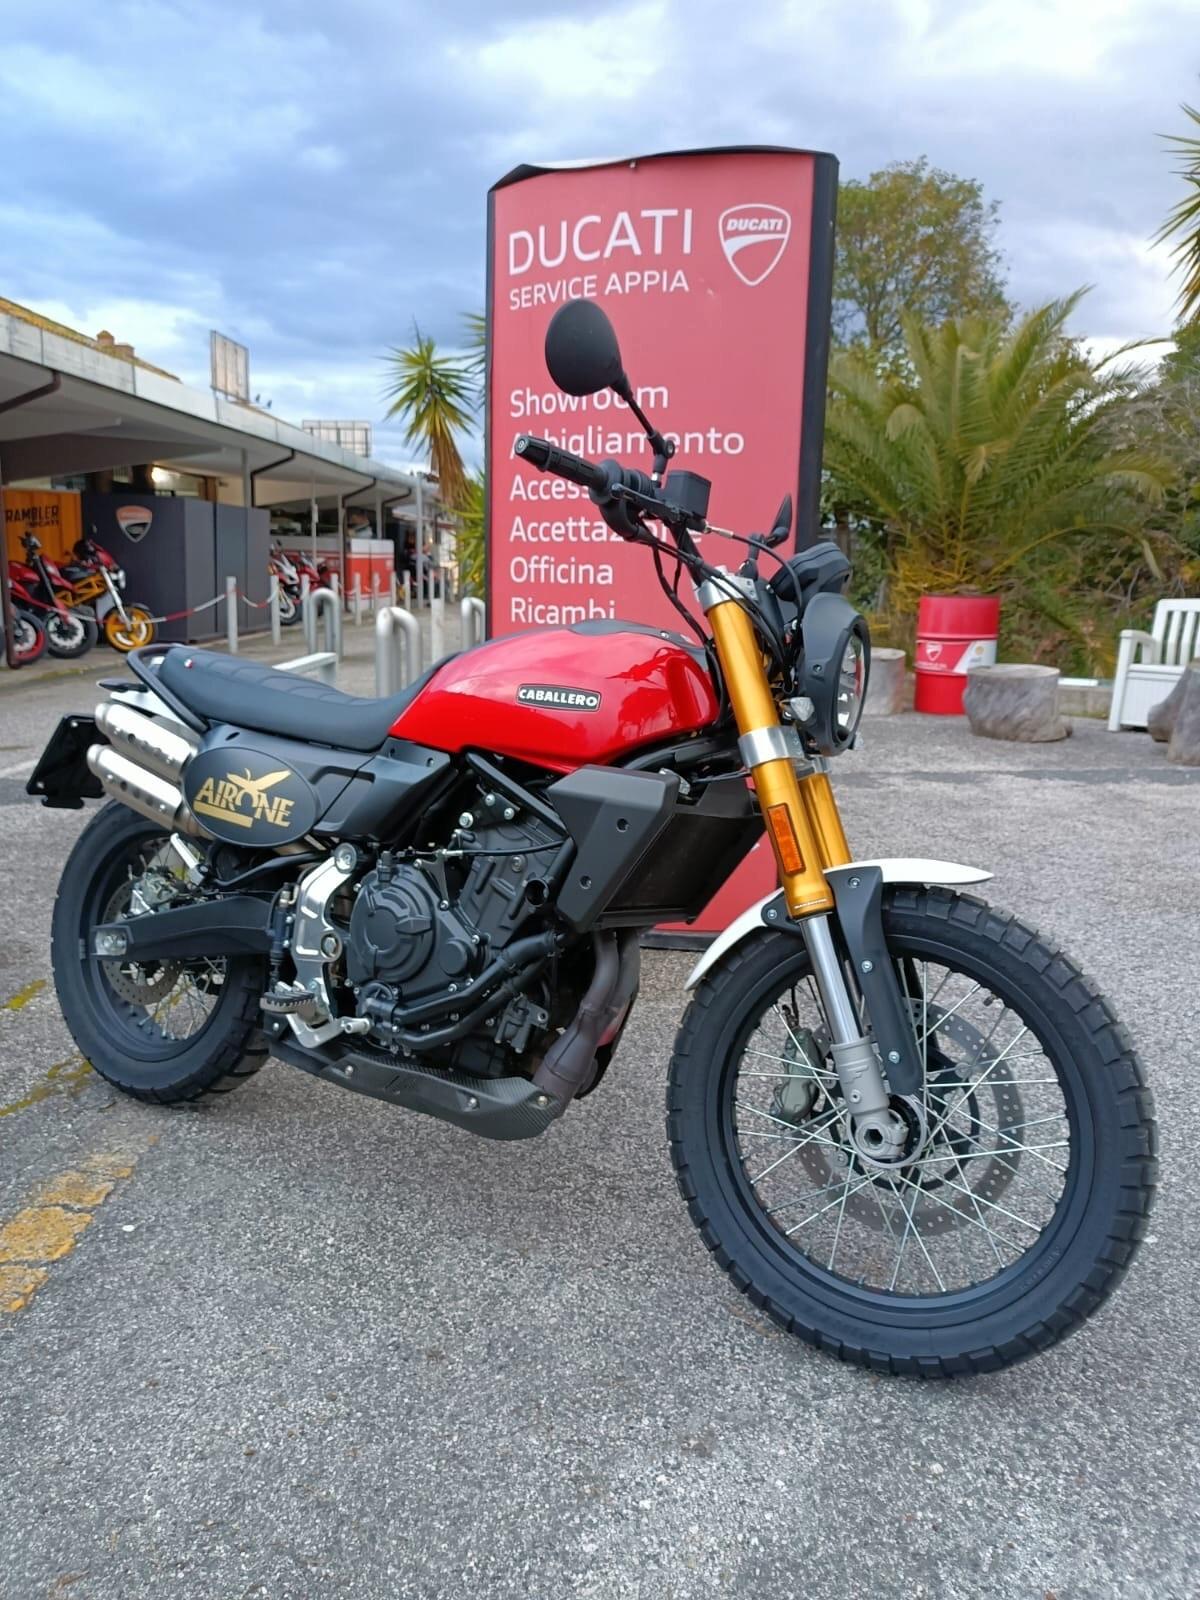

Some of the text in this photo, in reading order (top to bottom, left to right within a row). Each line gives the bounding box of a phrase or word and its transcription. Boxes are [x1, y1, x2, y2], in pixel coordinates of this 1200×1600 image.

[726, 218, 784, 231] DUCATI
[508, 208, 692, 276] DUCATI
[509, 269, 690, 311] SERVICE APPIA
[509, 425, 744, 460] bigliamento
[509, 474, 590, 501] Acces
[5, 505, 60, 523] RAMBLER
[509, 515, 703, 543] Accetta
[510, 555, 614, 585] Officina
[511, 597, 616, 625] Ricambi
[518, 689, 598, 707] CABALLERO
[195, 776, 295, 827] AIRONE
